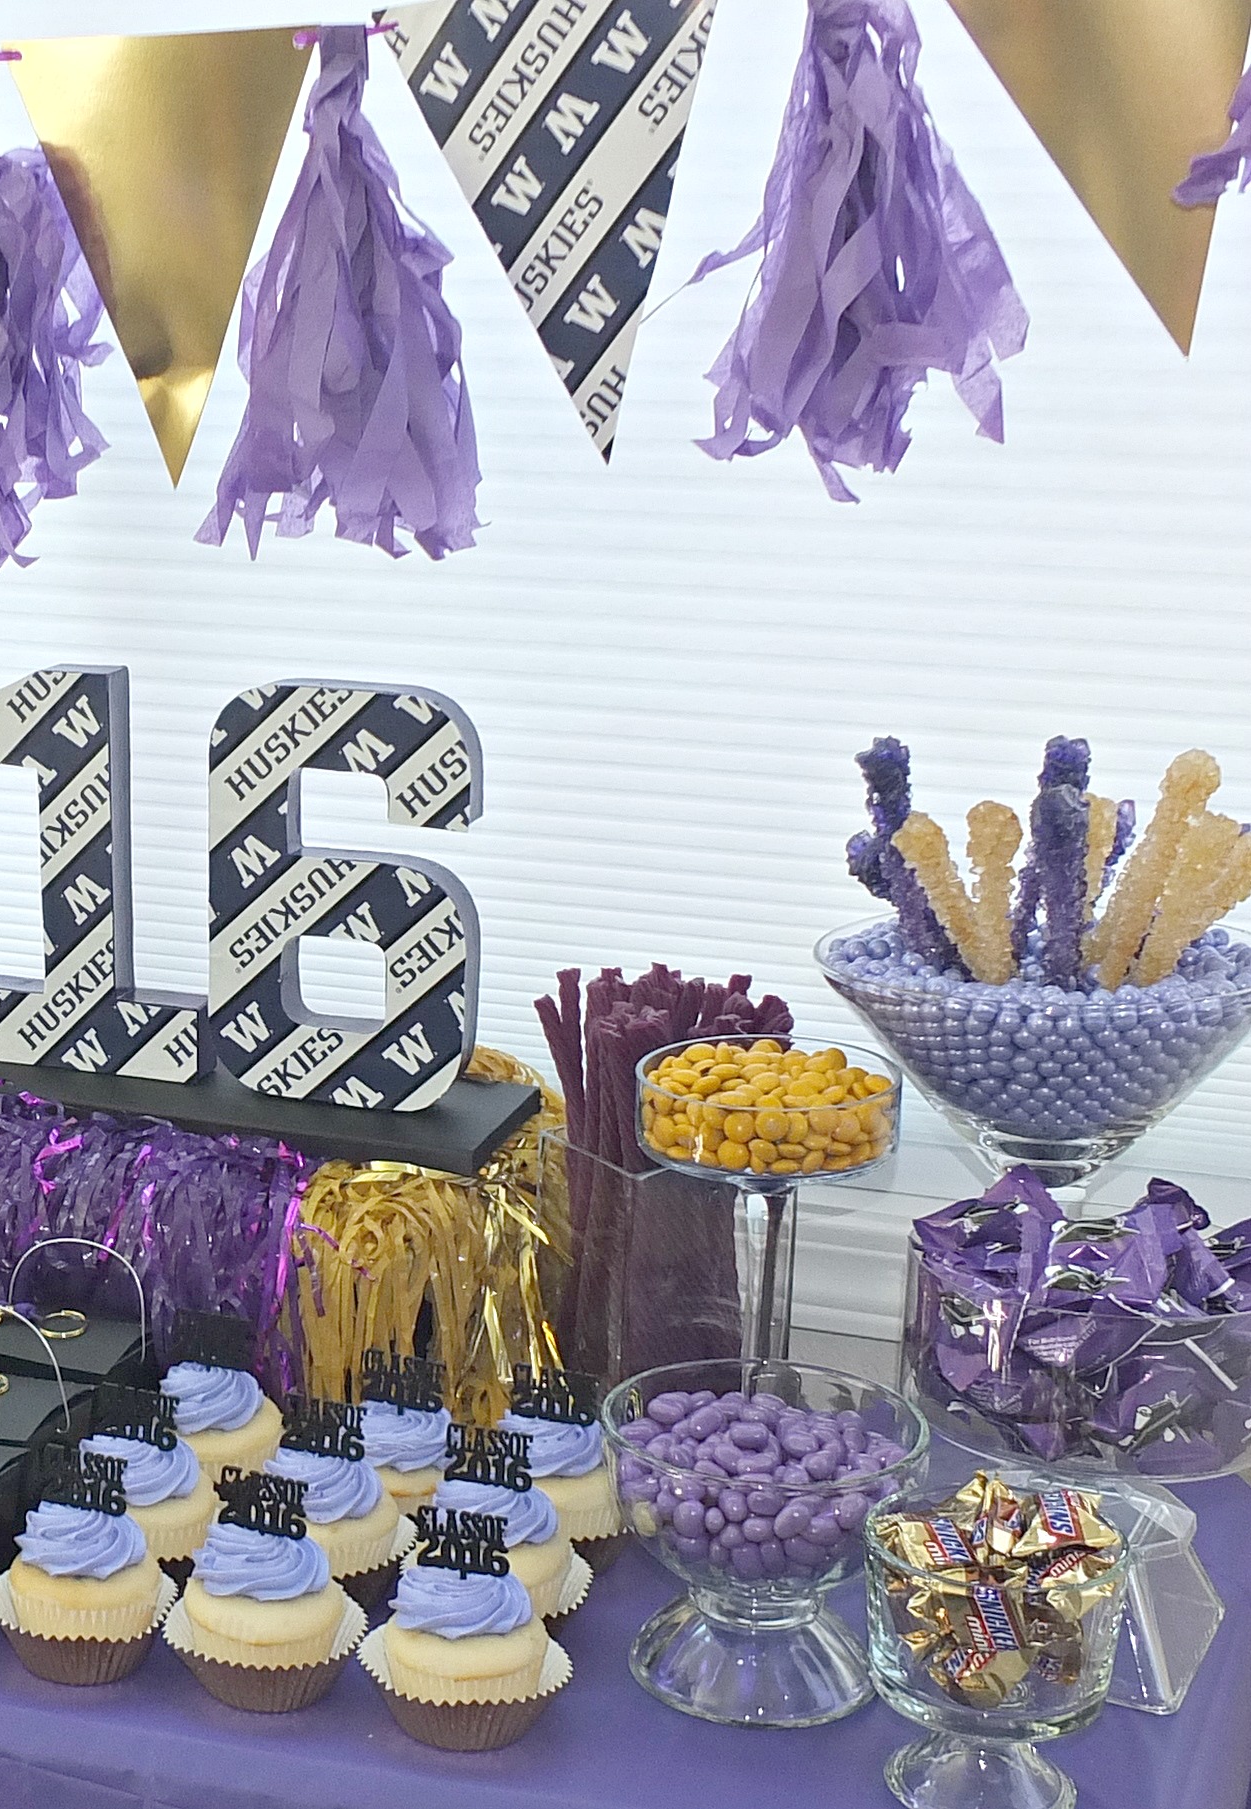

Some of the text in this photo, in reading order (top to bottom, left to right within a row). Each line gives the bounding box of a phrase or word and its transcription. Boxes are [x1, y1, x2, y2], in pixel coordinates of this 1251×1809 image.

[590, 10, 652, 74] W
[420, 42, 472, 104] W
[469, 0, 586, 154] HUSKIES
[542, 92, 599, 155] W
[491, 155, 545, 216] W
[563, 274, 620, 333] W
[52, 694, 103, 748] W
[224, 687, 354, 800] HUSKIES
[227, 835, 281, 889] W
[62, 874, 111, 925] W
[229, 857, 356, 968] HUSKIES
[61, 1028, 111, 1072] W
[220, 1000, 275, 1054] W
[381, 1022, 438, 1076] W
[444, 1449, 533, 1492] 2016
[218, 1500, 307, 1540] 2016
[417, 1537, 509, 1577] 2016
